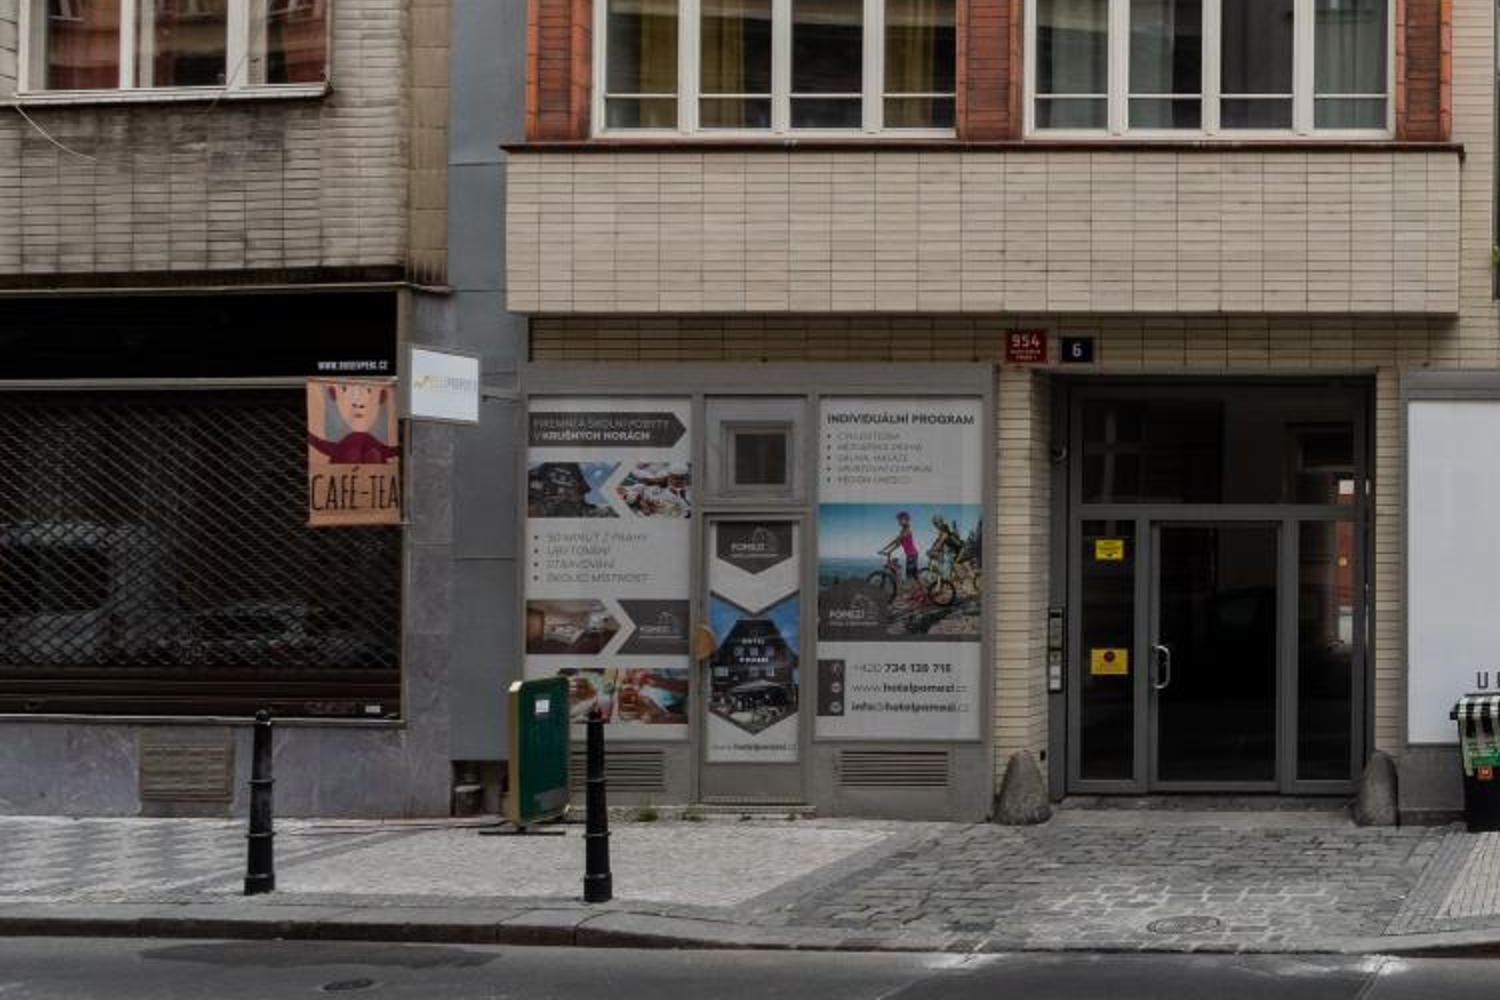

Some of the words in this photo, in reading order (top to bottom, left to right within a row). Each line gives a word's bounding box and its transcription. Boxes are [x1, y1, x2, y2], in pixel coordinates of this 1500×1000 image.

[1011, 333, 1041, 348] 954
[1072, 343, 1083, 357] 6
[827, 412, 909, 424] INDIVIDUÁLNÍ
[912, 413, 975, 425] PROGRAM
[604, 430, 651, 441] HORÁCH
[311, 467, 400, 511] CAFÉ-TEA
[1477, 671, 1490, 689] U
